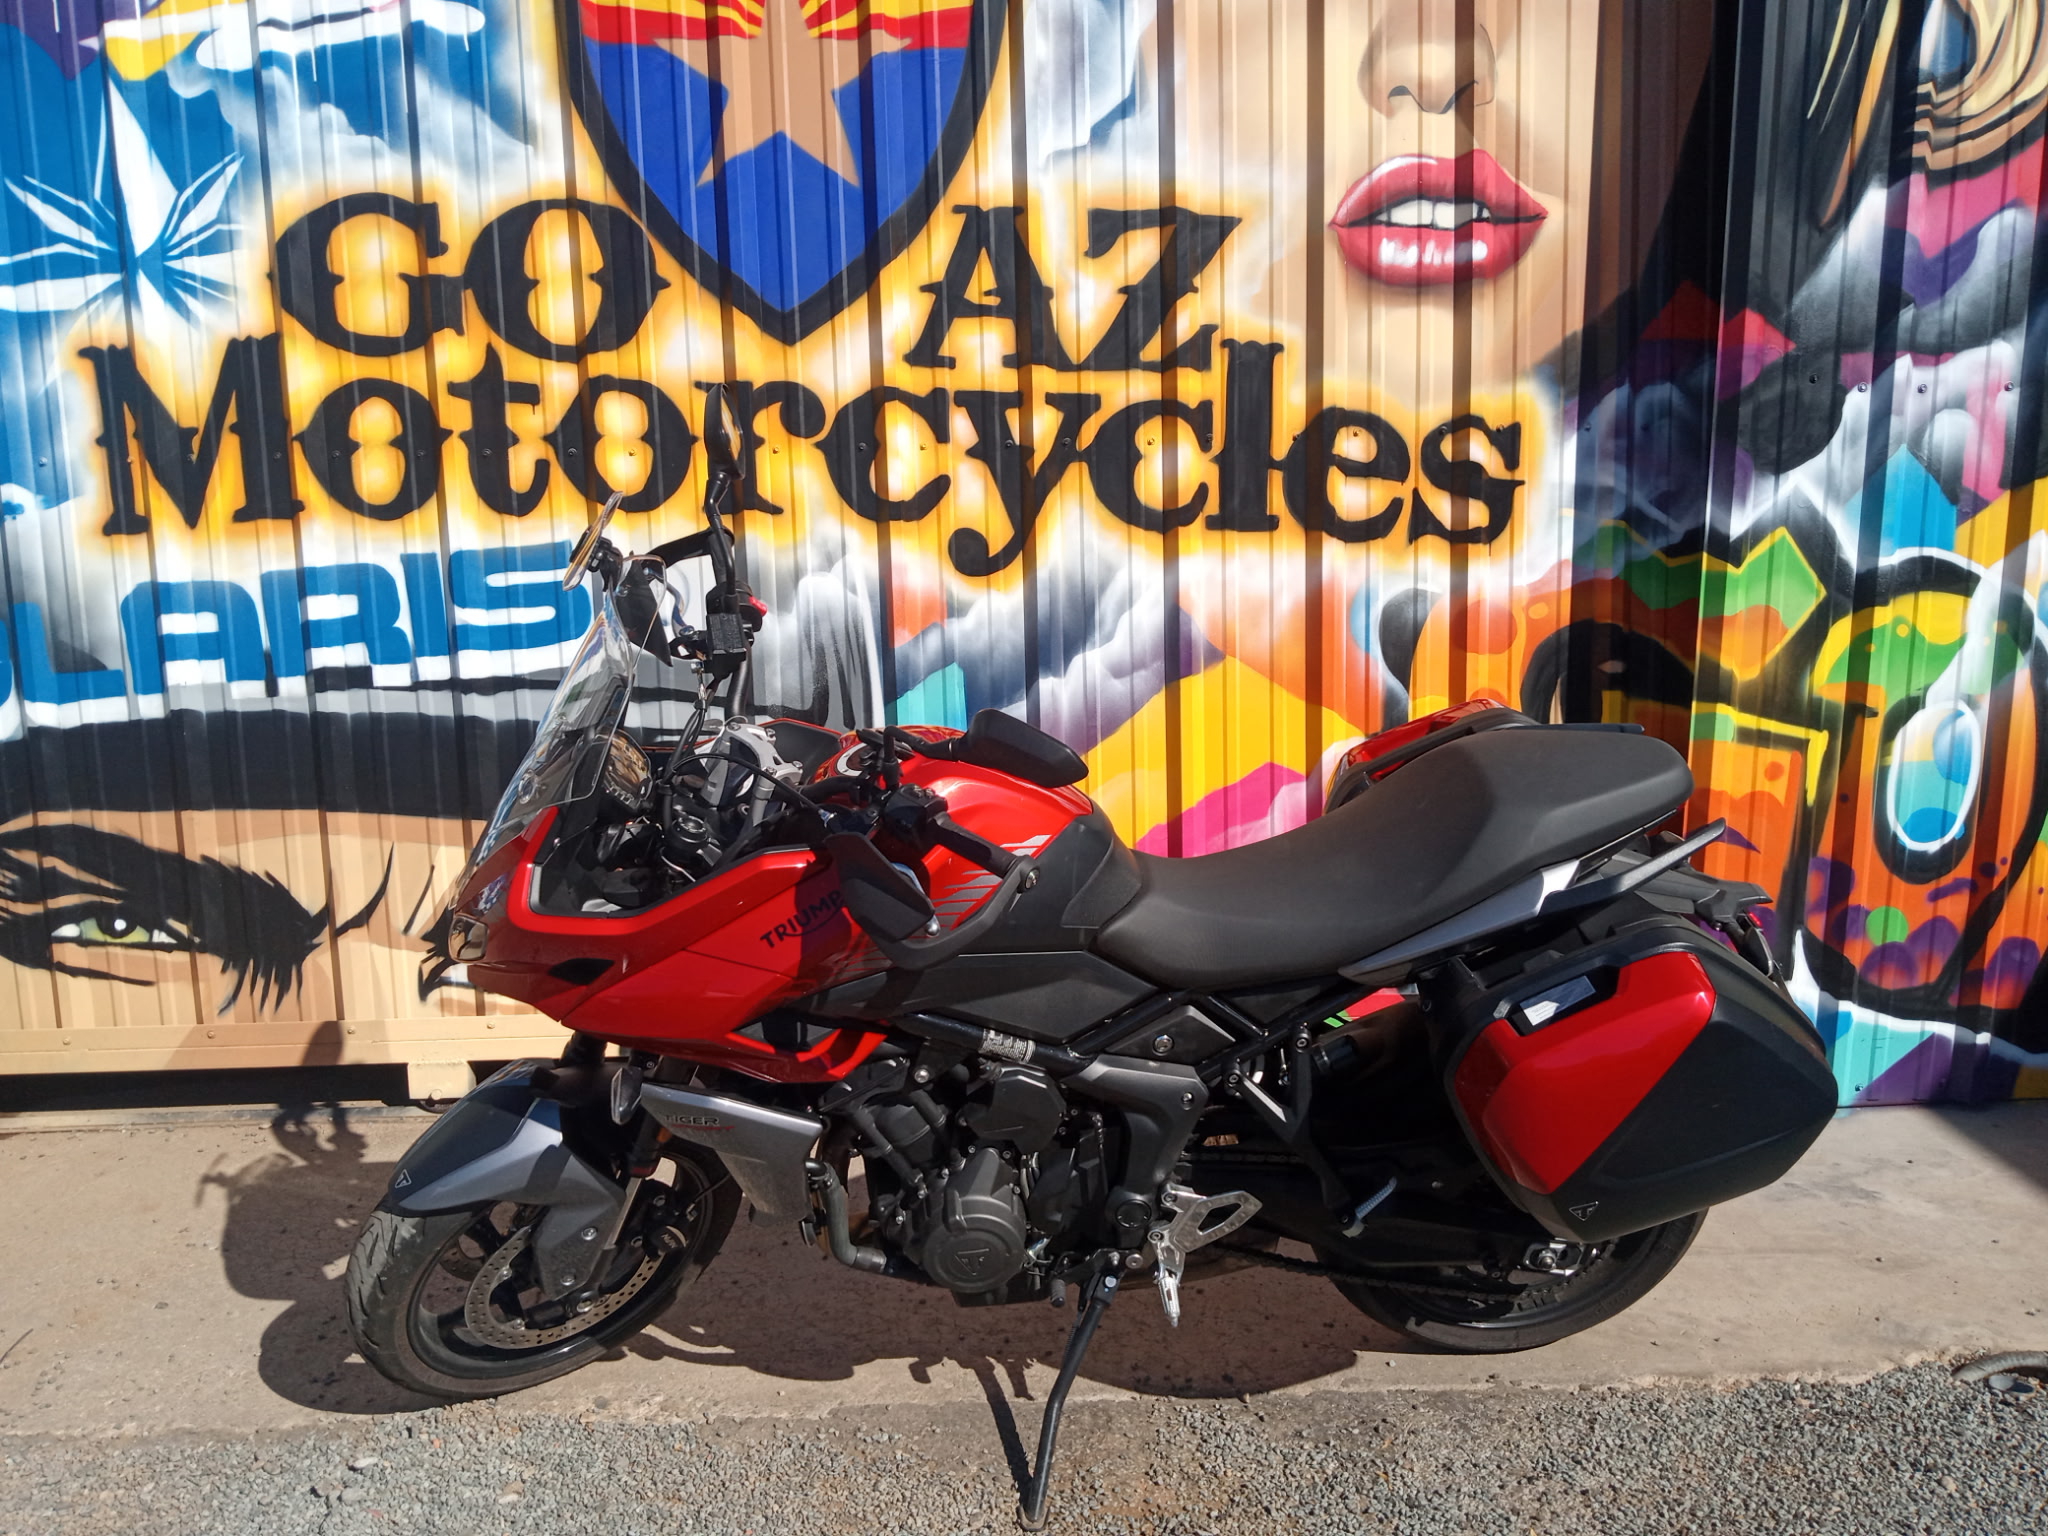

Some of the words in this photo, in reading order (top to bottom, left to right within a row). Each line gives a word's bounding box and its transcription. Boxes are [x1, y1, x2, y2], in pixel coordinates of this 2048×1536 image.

[267, 191, 671, 364] GO
[903, 204, 1243, 373] AZ
[77, 332, 1526, 578] Motorcycles
[0, 540, 593, 706] LARIS
[760, 889, 842, 949] TRIUMP
[664, 1114, 720, 1127] TIGER
